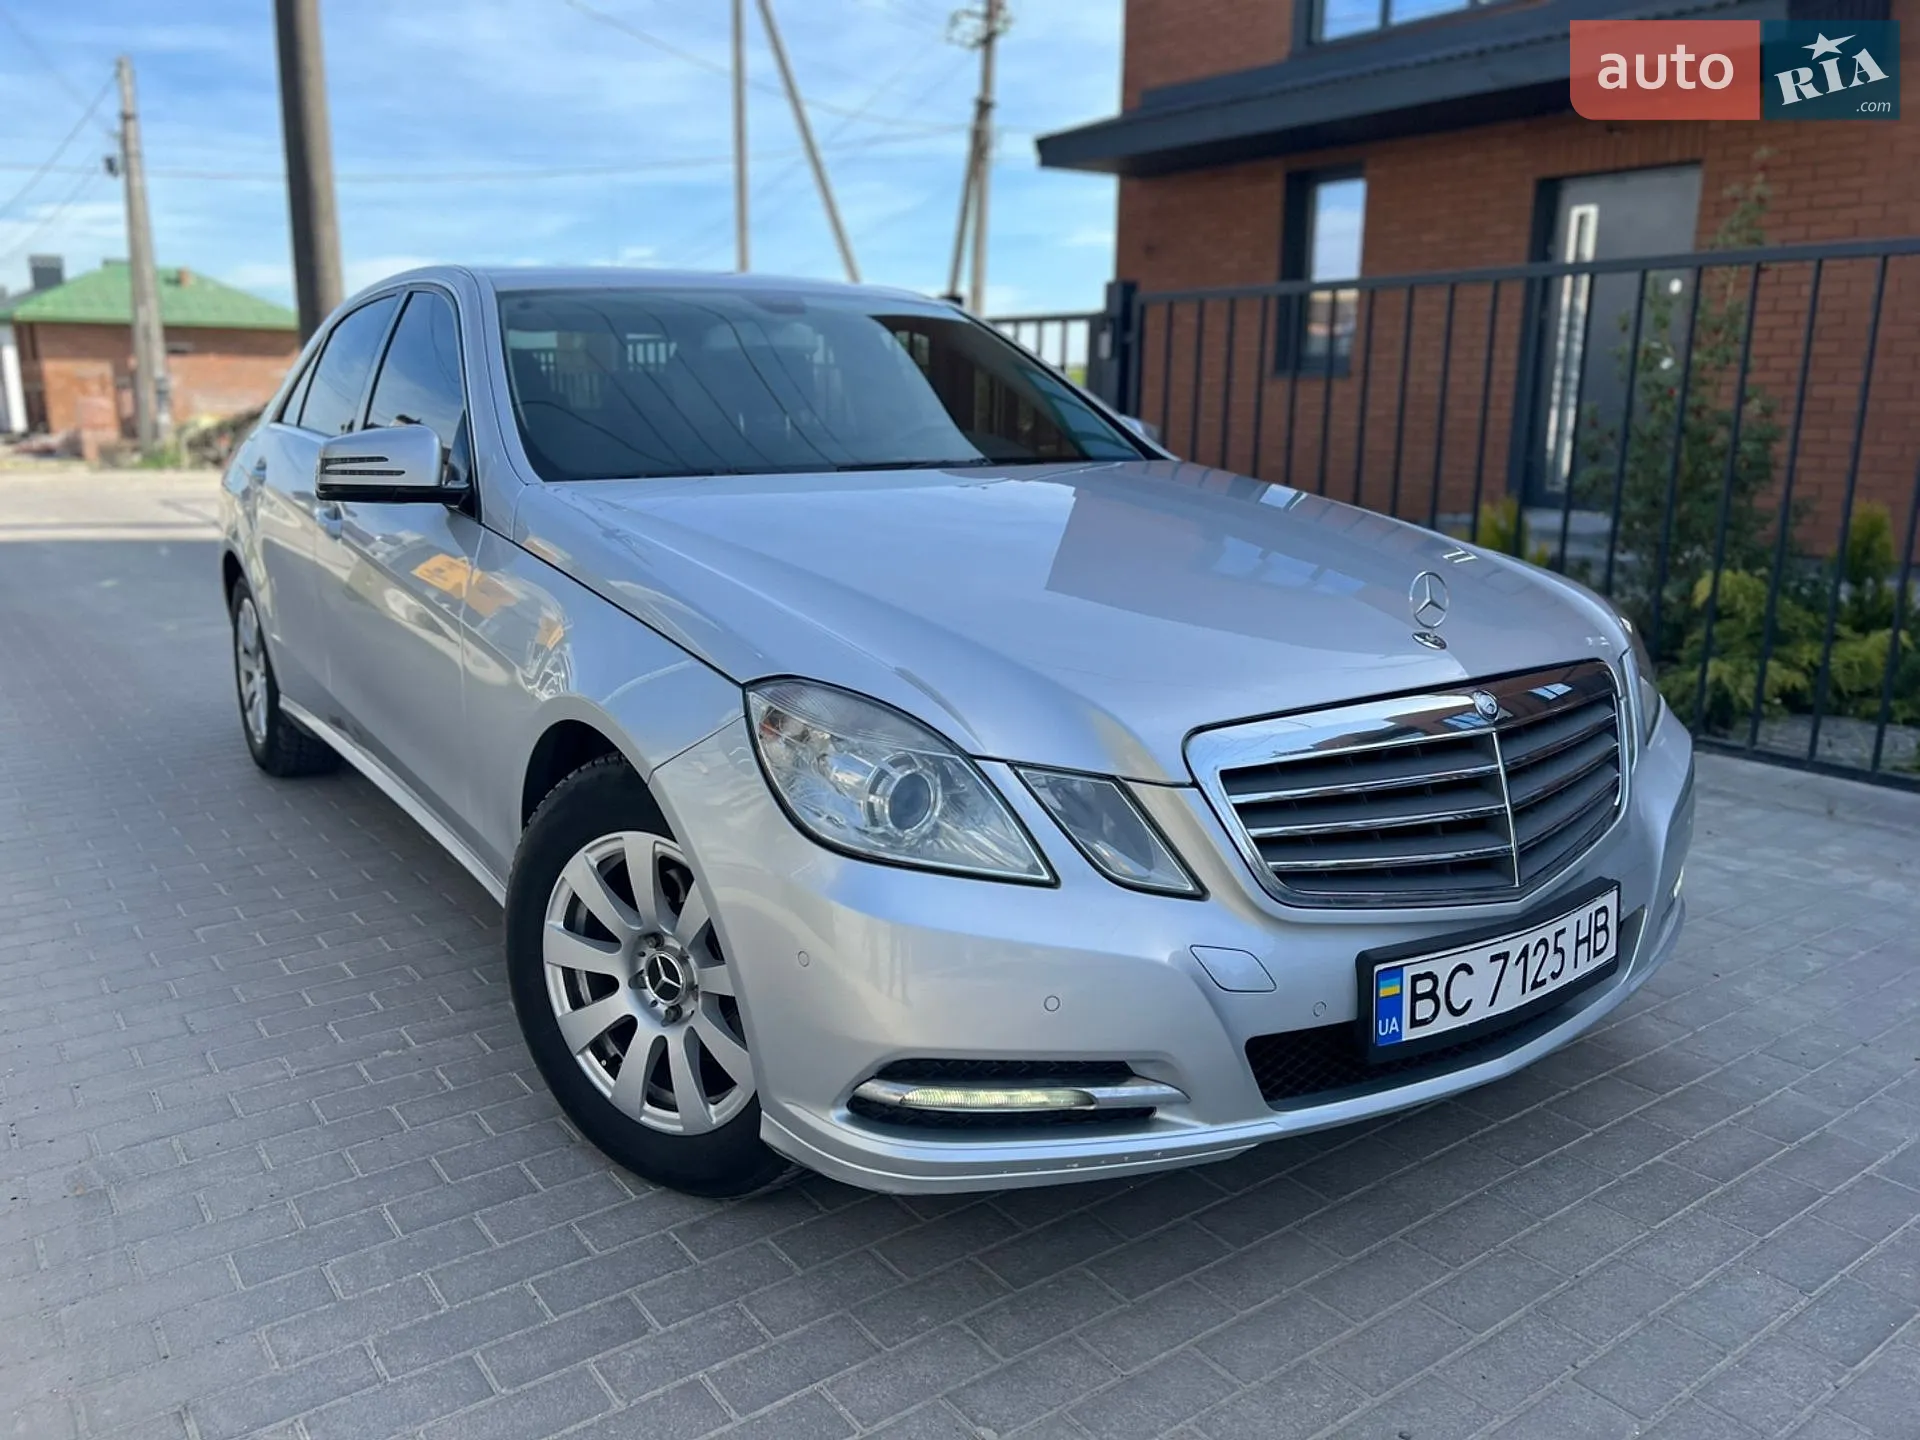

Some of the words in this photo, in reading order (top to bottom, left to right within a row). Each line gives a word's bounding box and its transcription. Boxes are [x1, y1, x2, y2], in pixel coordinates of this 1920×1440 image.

[1409, 962, 1474, 1030] BC
[1488, 927, 1566, 1007] 7125
[1573, 905, 1610, 969] HB
[1378, 1018, 1399, 1036] UA
